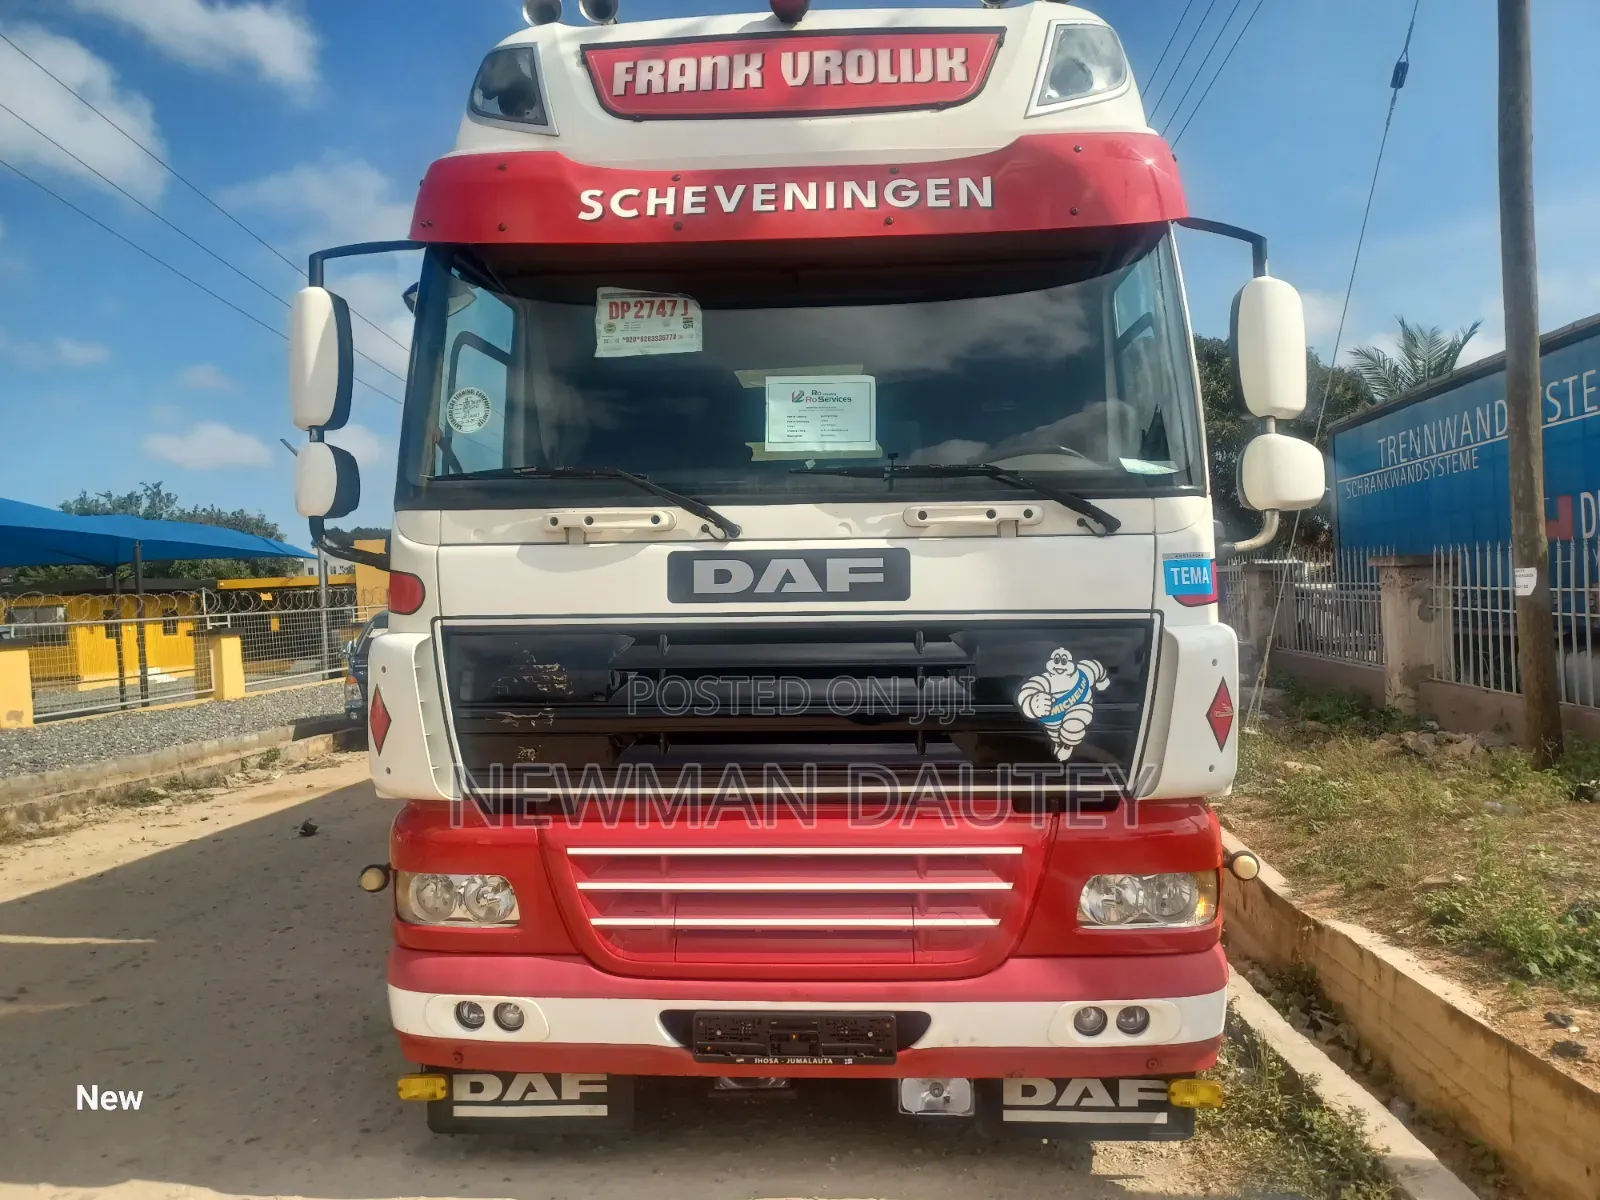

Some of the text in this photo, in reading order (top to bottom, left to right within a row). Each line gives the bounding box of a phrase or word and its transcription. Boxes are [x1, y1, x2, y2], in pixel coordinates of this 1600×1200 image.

[612, 47, 968, 96] FRANK VROLIJK
[578, 176, 993, 222] SCHEVENINGEN
[609, 300, 631, 320] DP
[634, 300, 677, 319] 2747
[1346, 448, 1479, 499] SCHRANKWANDSYSTEME
[693, 557, 884, 594] DAF
[1170, 567, 1210, 586] TEMA
[1051, 677, 1087, 716] MICHELIN
[786, 1057, 833, 1065] JUMALAUTA
[453, 1073, 608, 1102] DAF
[1003, 1078, 1168, 1107] DAF
